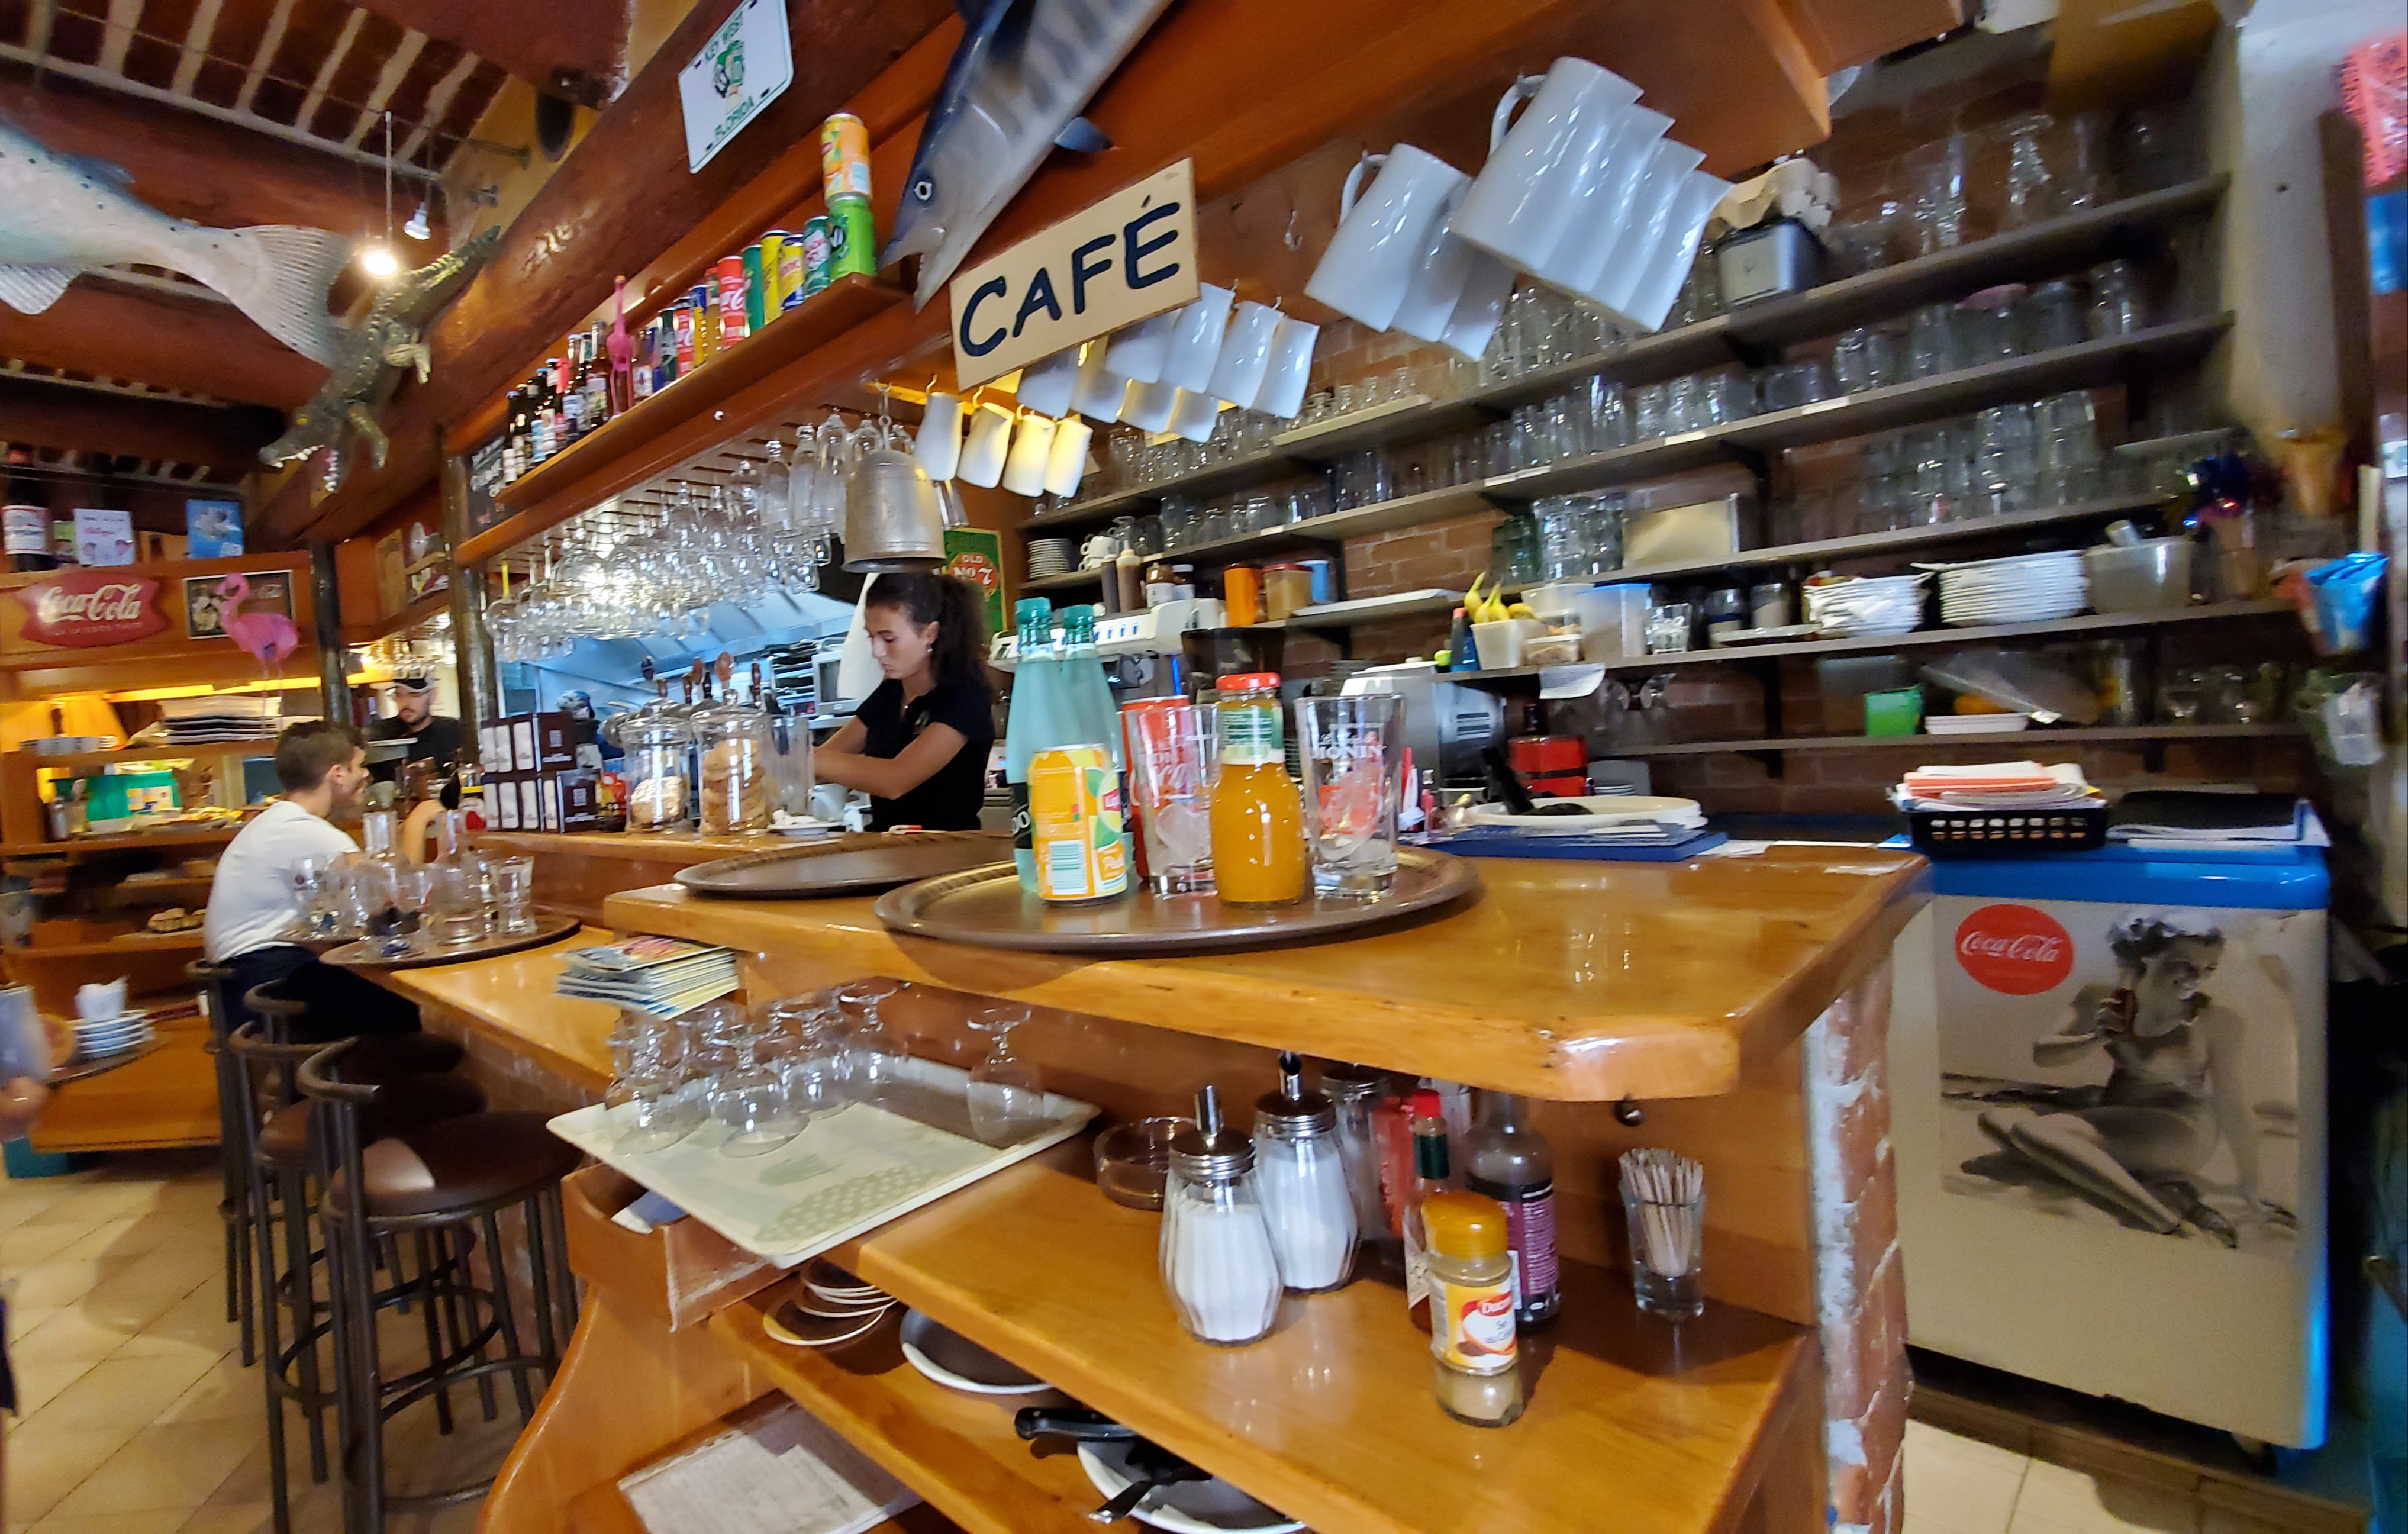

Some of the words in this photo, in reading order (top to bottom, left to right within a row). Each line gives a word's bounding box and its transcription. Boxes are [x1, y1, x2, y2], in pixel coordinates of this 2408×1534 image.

[960, 194, 1180, 357] CAFÉ
[962, 554, 984, 564] OLD
[978, 568, 994, 585] 7
